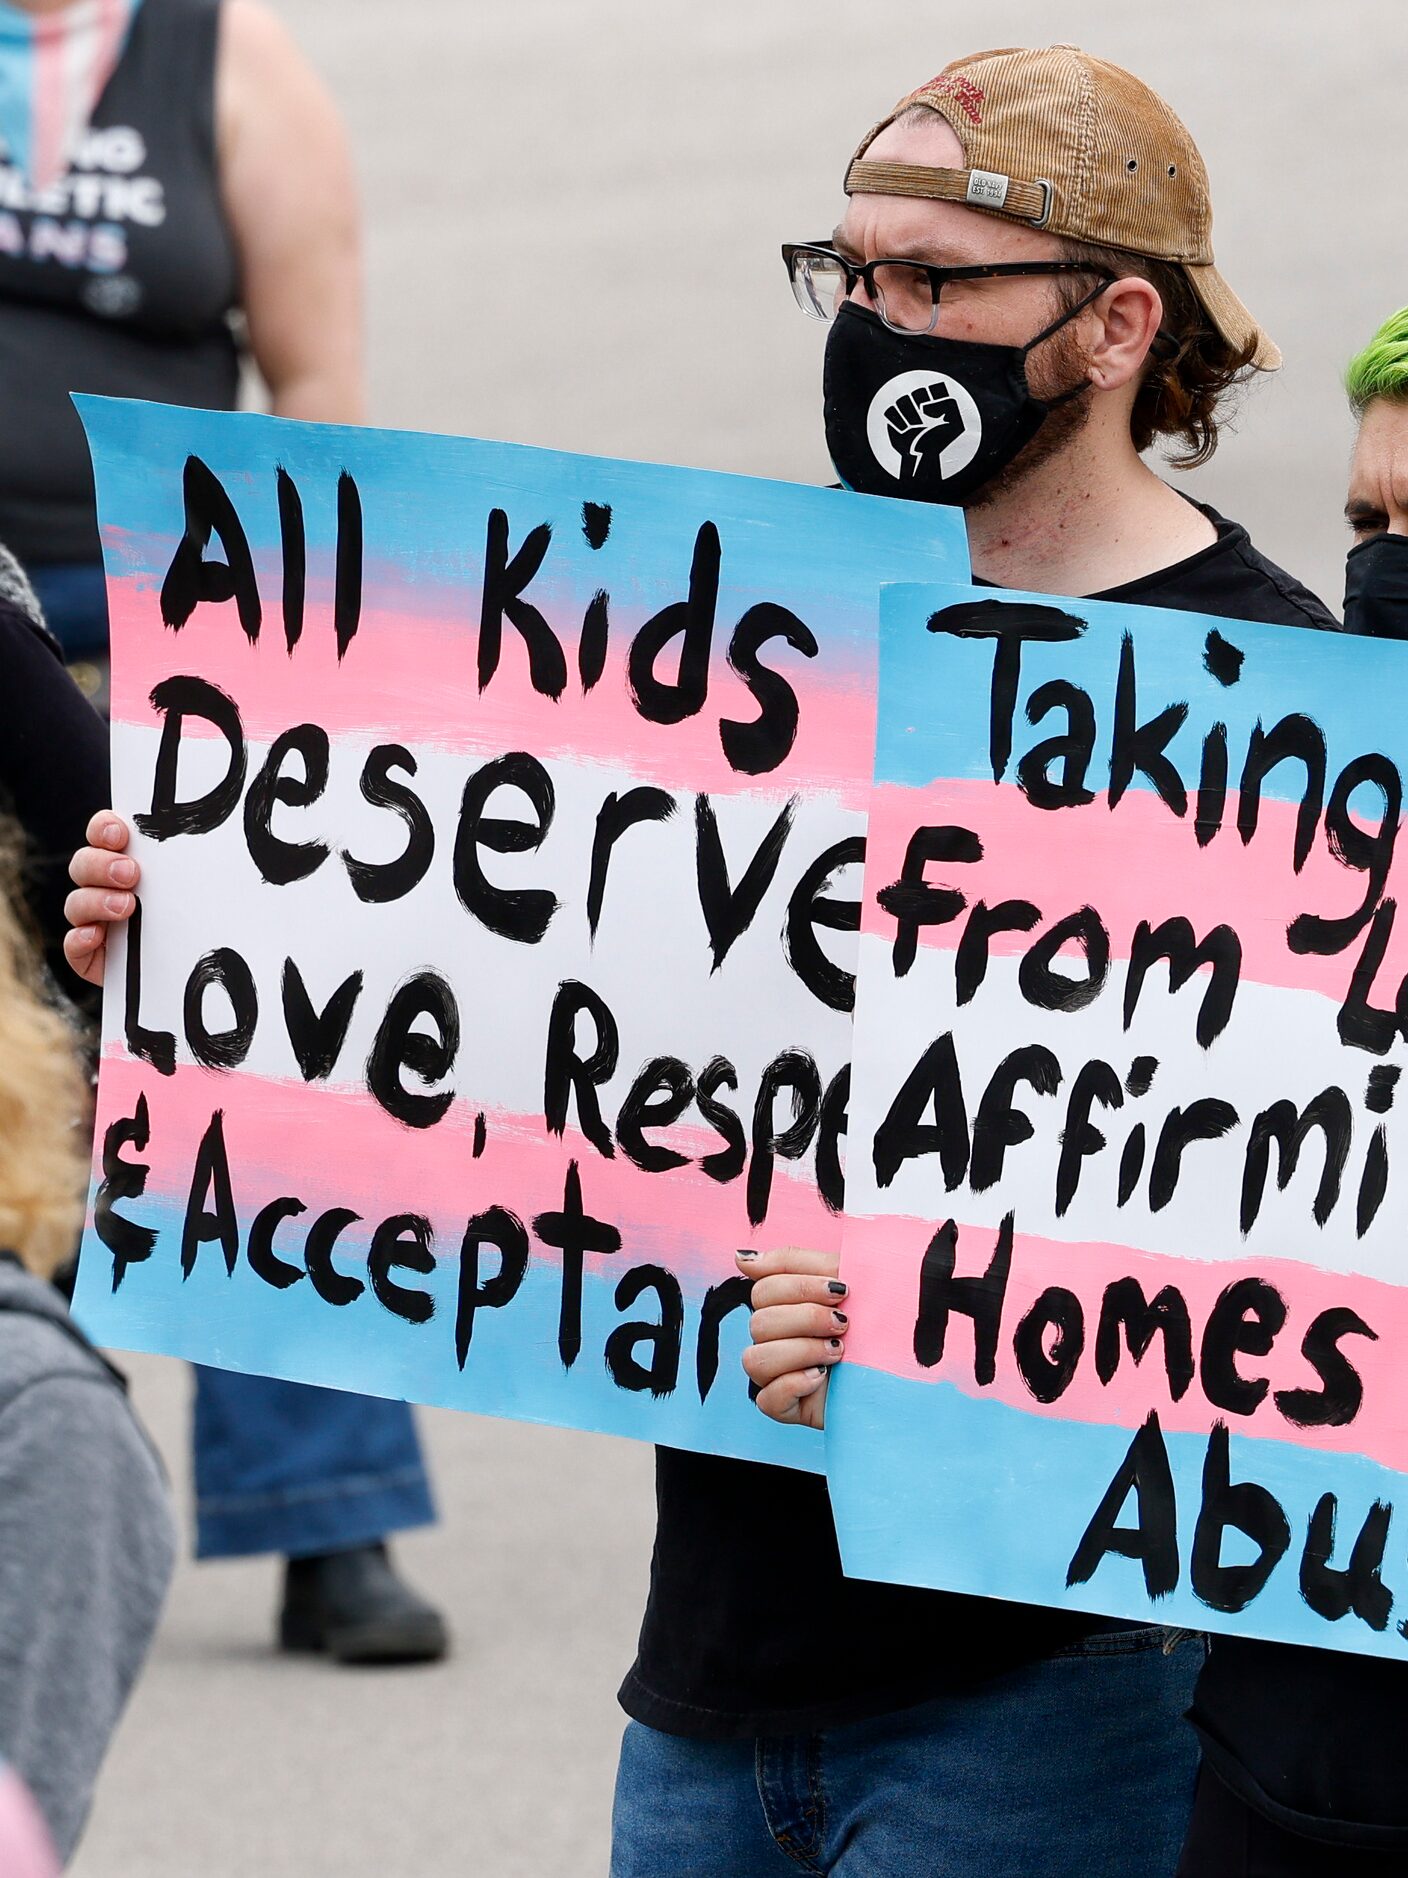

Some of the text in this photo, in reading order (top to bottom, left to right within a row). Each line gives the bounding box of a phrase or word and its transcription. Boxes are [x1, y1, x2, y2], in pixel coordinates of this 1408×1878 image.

[973, 177, 987, 187] OLD
[160, 453, 819, 776] All Kids
[133, 675, 867, 1014] Deserve
[925, 599, 1404, 956] Taking
[125, 894, 487, 1159] Love,
[912, 1209, 1381, 1428] Homes
